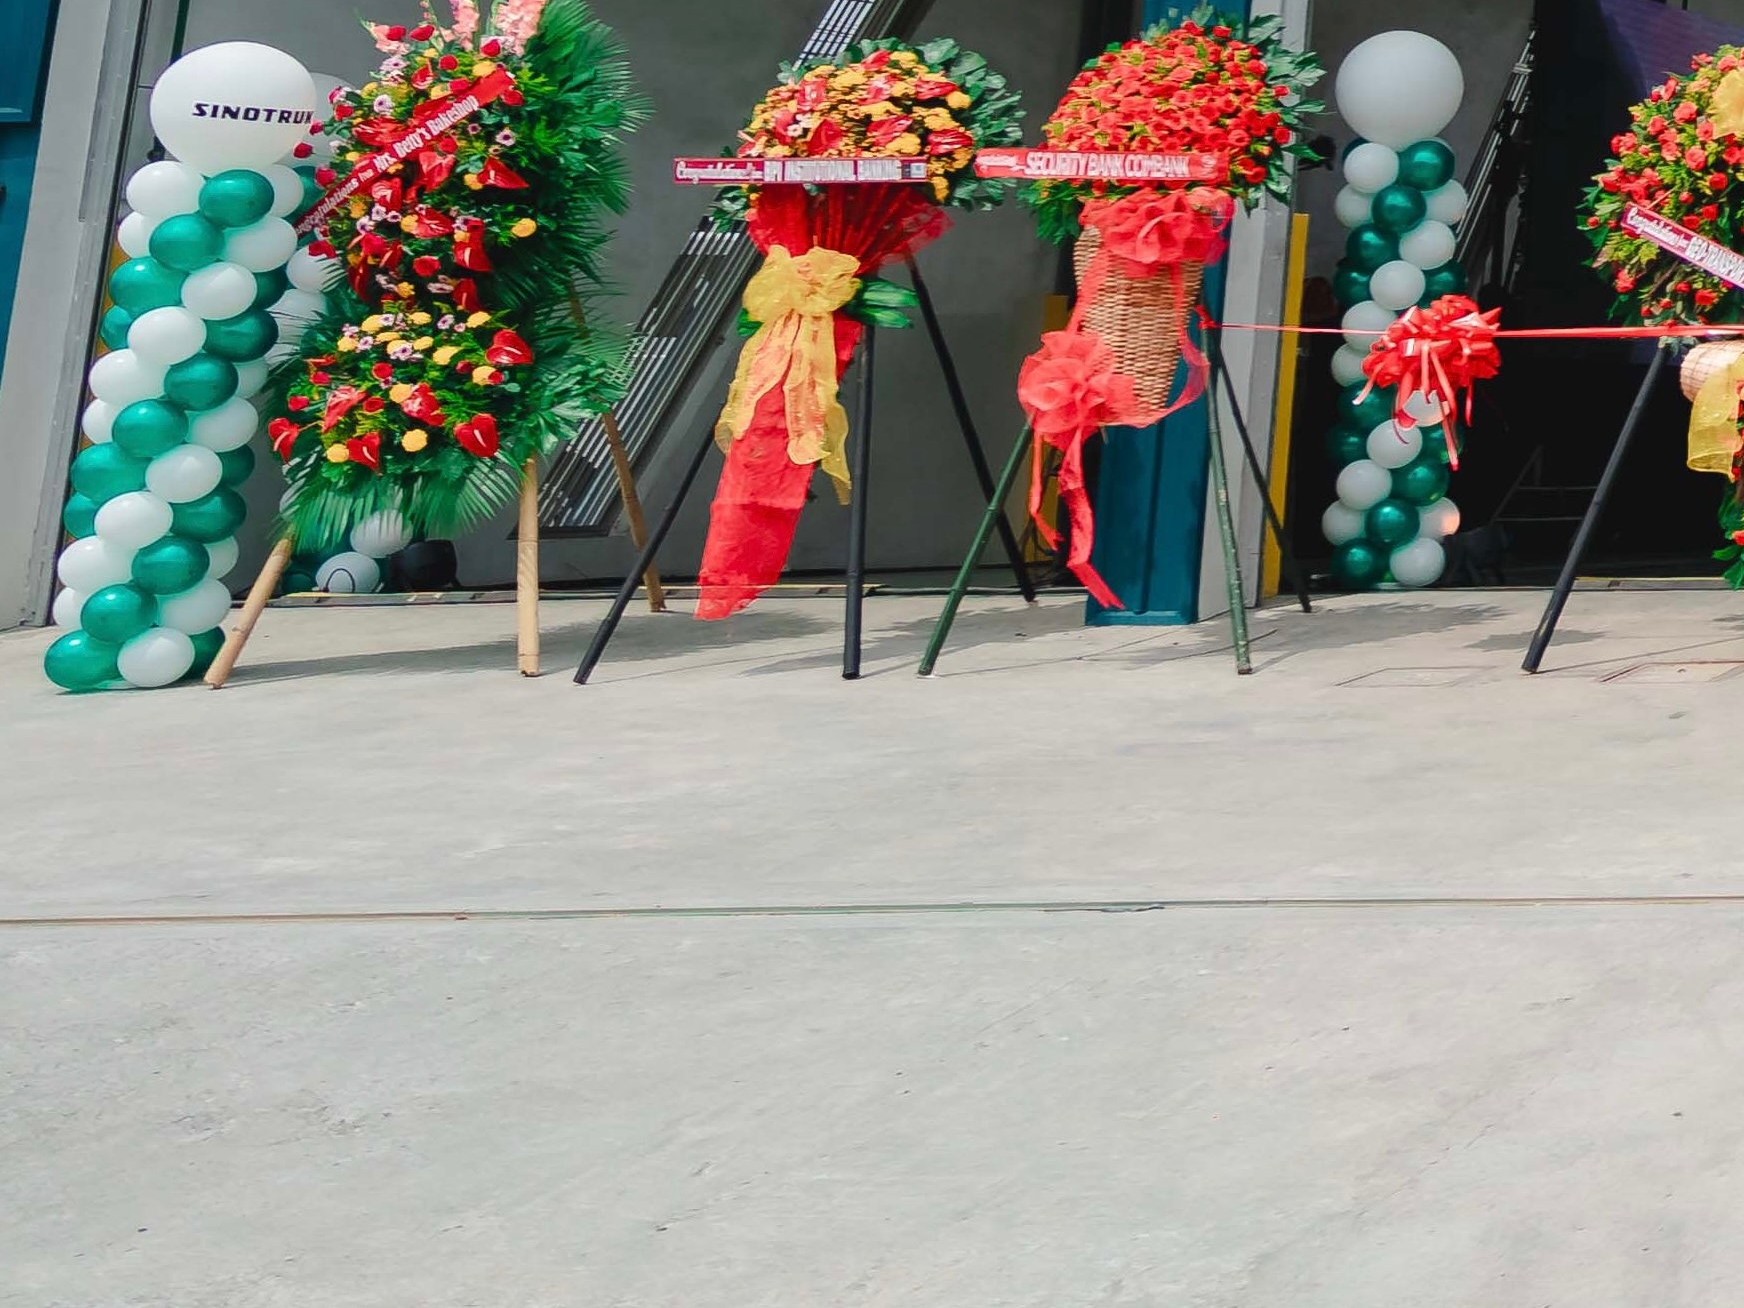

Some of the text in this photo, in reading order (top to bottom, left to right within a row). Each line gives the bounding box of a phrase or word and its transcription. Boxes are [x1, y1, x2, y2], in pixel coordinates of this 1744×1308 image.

[192, 102, 316, 125] SINOTRUK
[393, 126, 433, 159] Betty's
[425, 94, 480, 137] Bakeshop
[1025, 151, 1088, 176] SECURITY
[1086, 153, 1125, 177] BANK
